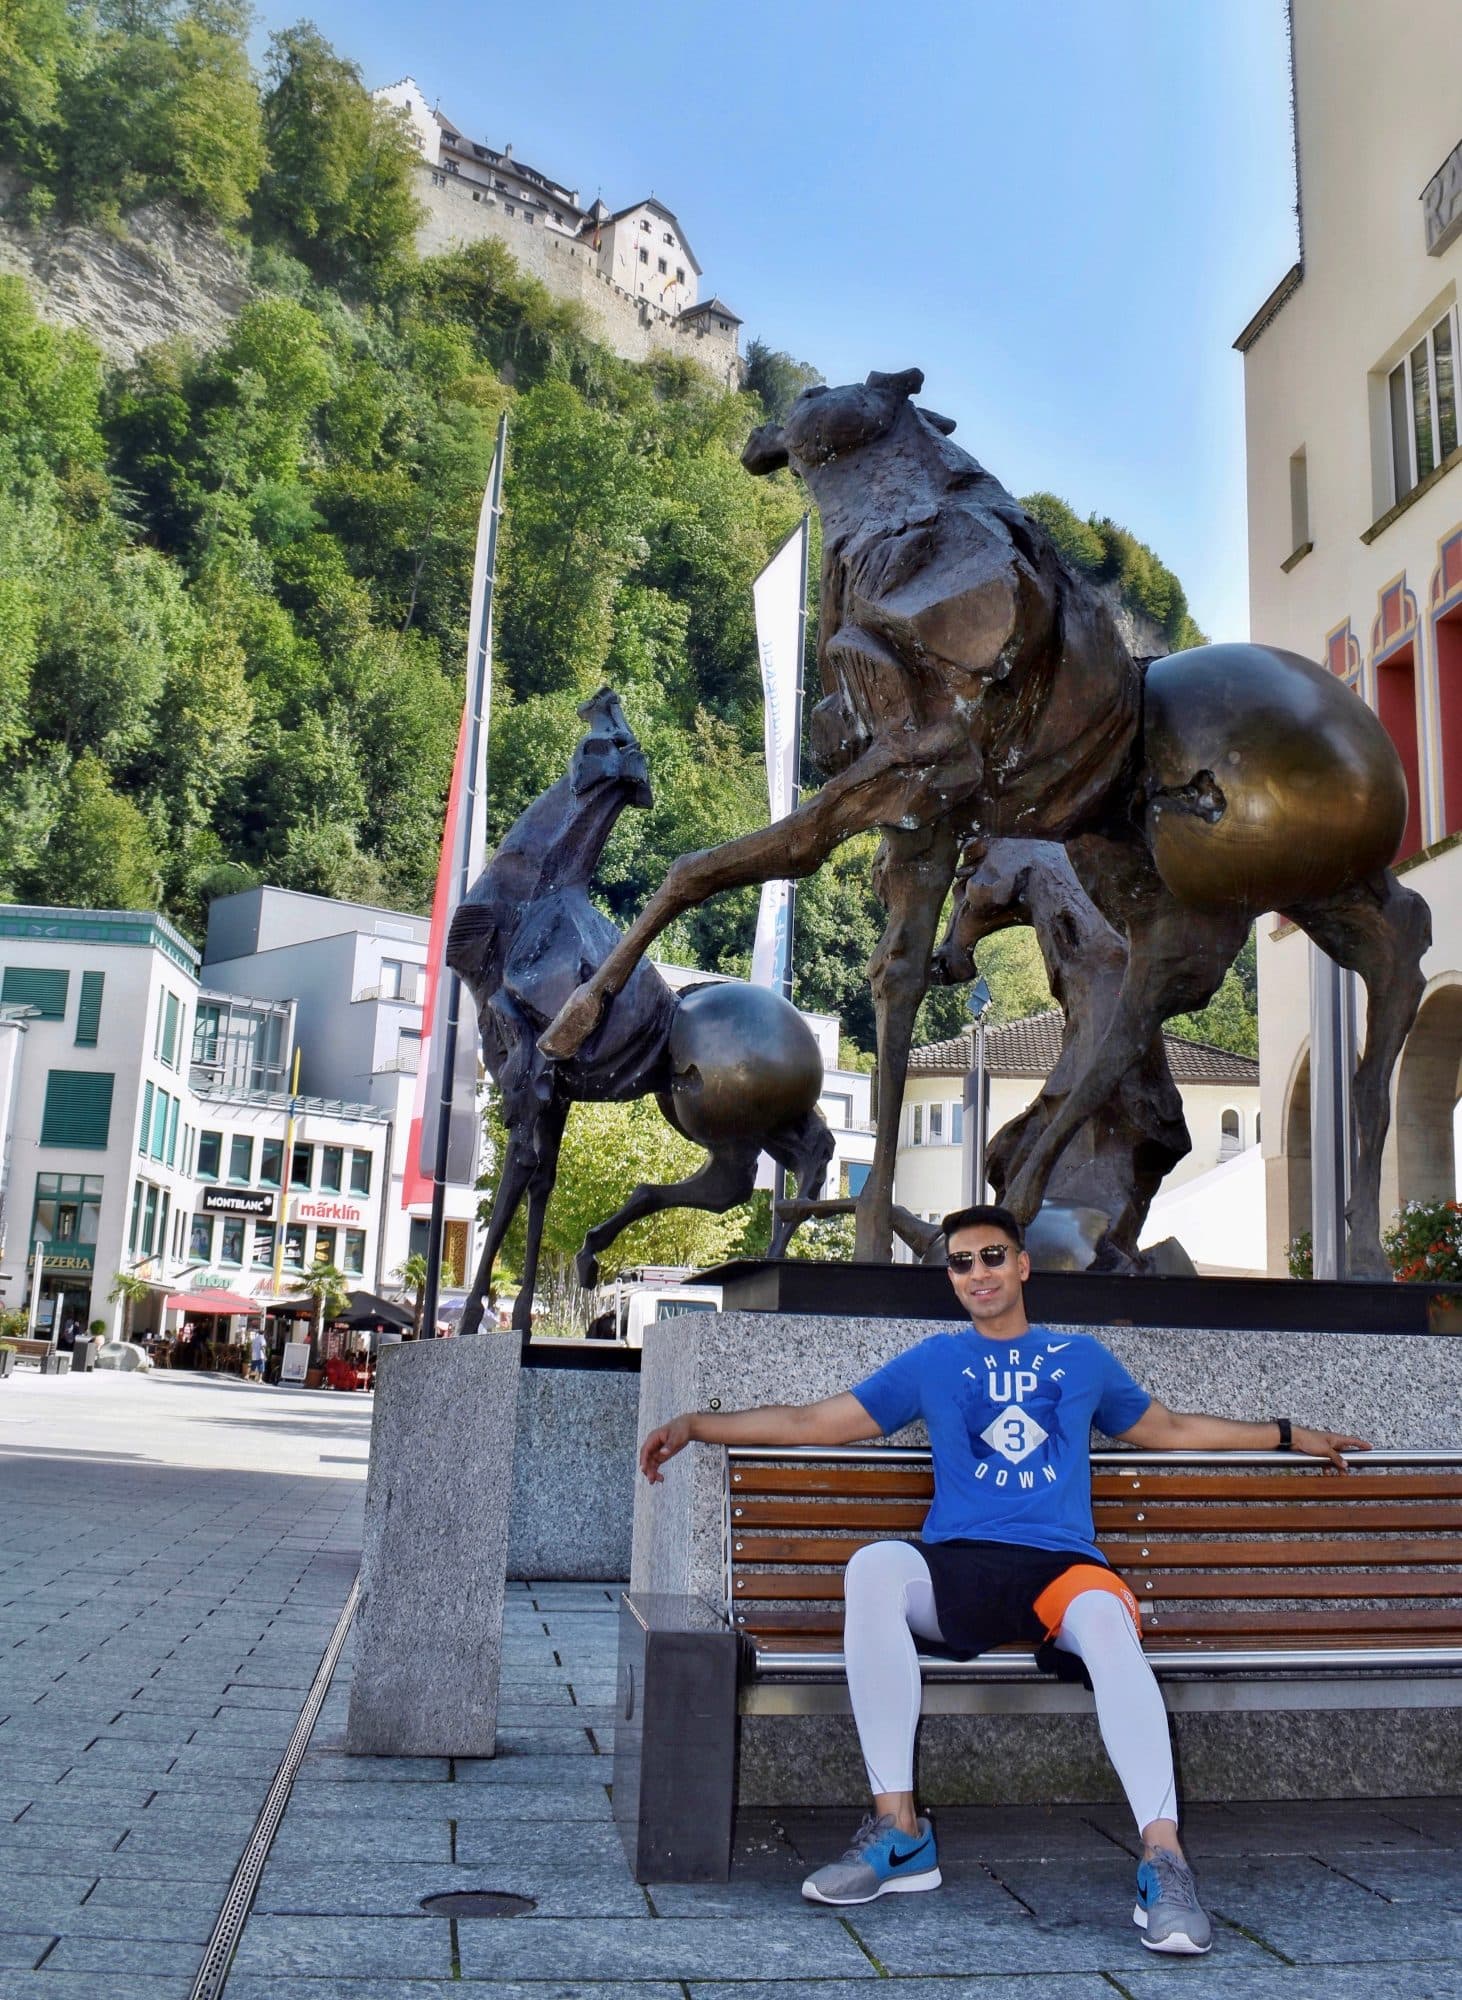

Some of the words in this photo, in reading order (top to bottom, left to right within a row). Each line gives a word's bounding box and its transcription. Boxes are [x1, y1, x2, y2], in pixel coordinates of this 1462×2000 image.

[207, 1196, 265, 1212] MONTBLANC
[300, 1202, 361, 1221] märklin
[29, 1255, 91, 1269] PZZERIA
[962, 1349, 1066, 1382] THREE
[989, 1371, 1038, 1402] UP
[1003, 1419, 1026, 1452] 3
[975, 1462, 1057, 1488] DOWN
